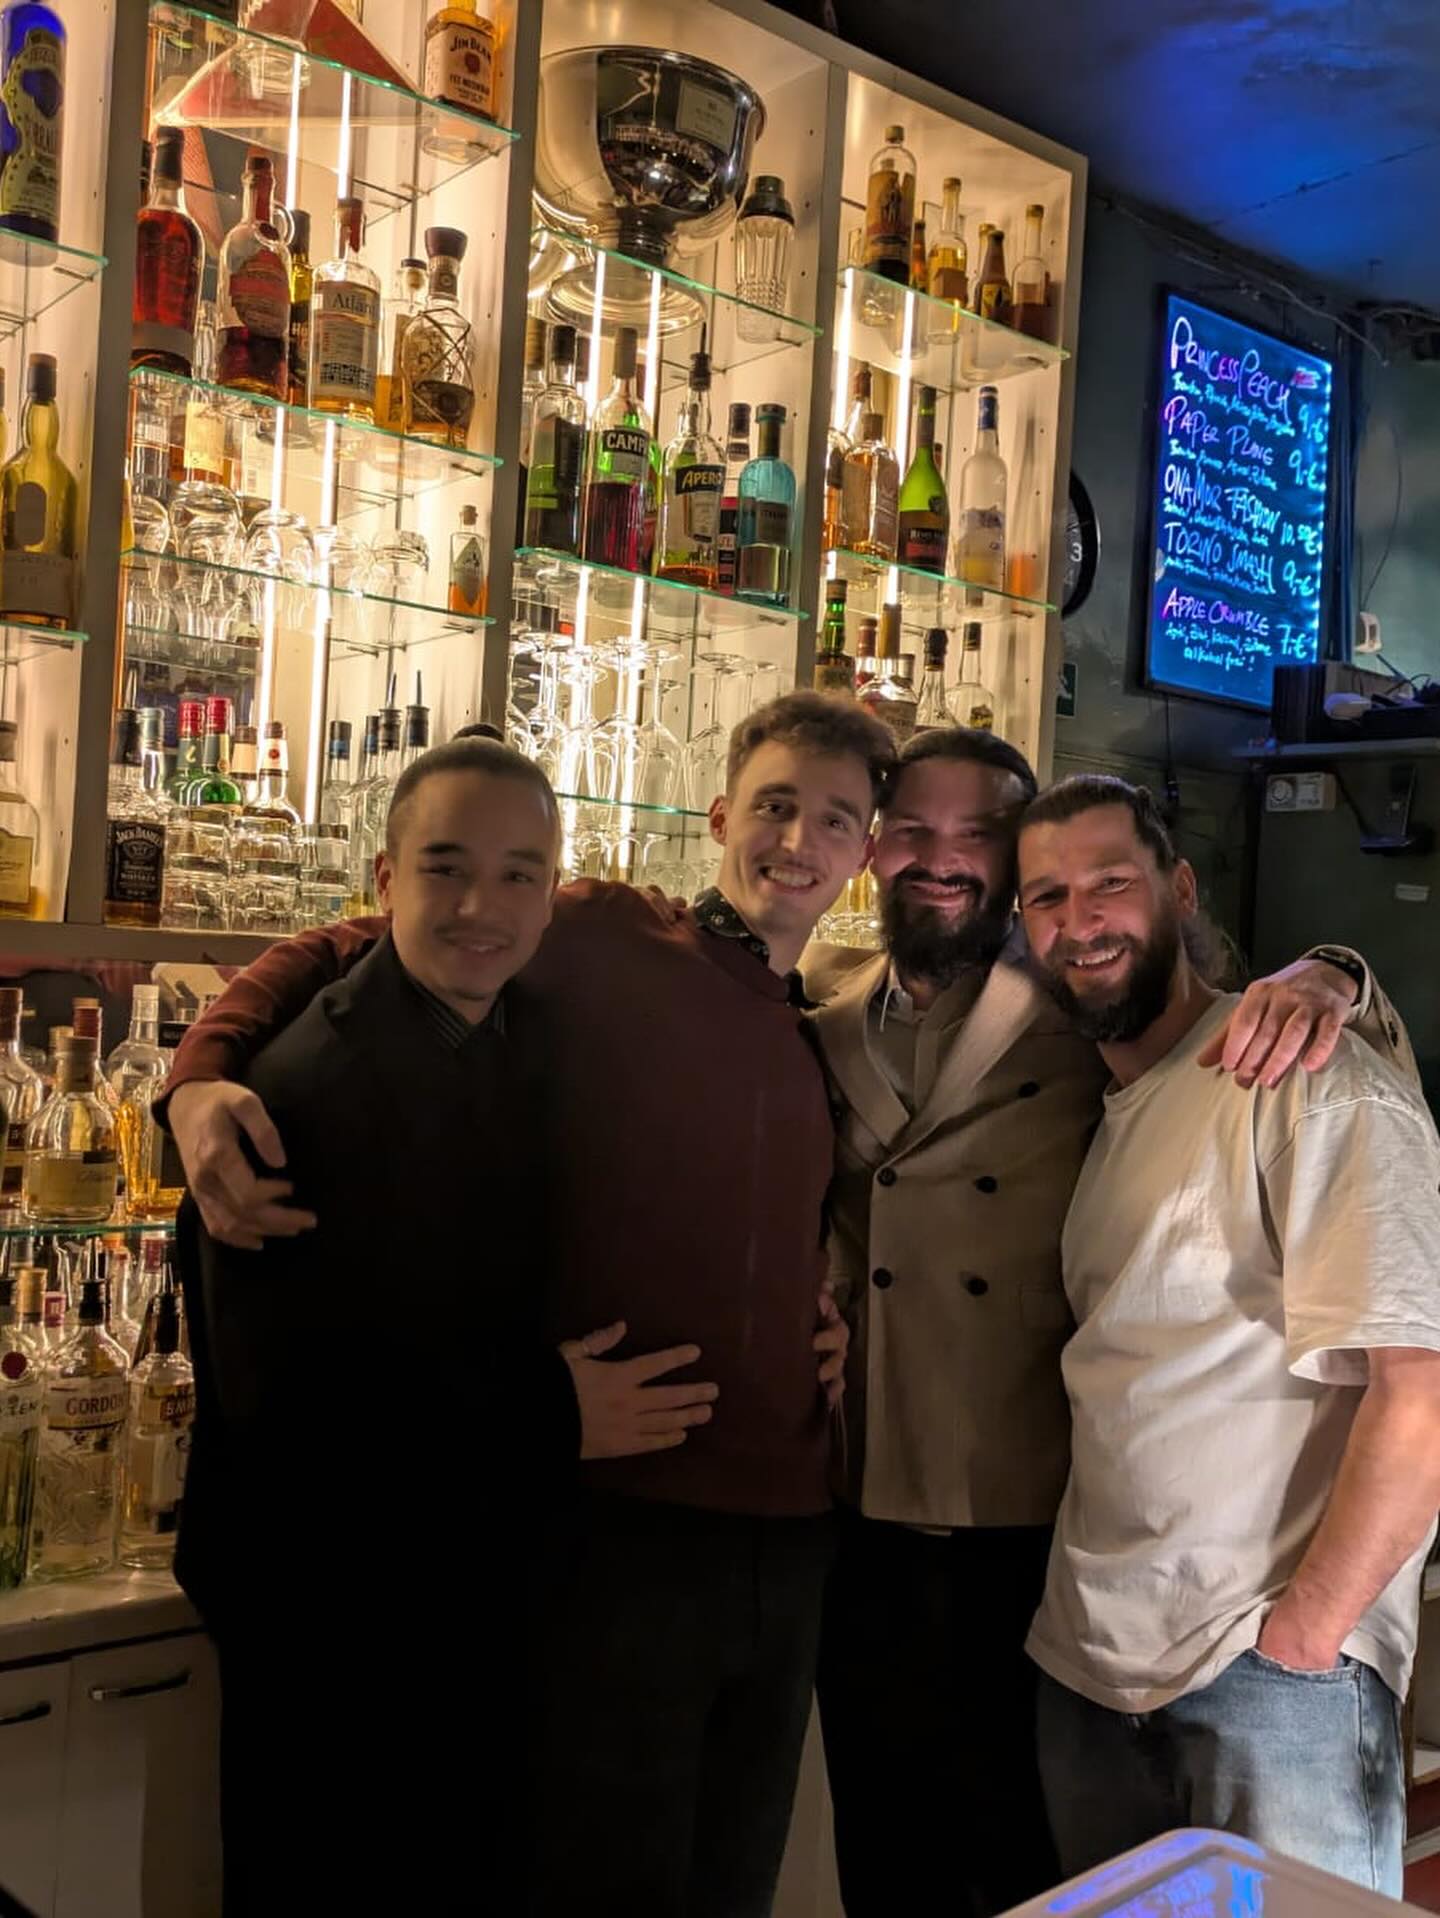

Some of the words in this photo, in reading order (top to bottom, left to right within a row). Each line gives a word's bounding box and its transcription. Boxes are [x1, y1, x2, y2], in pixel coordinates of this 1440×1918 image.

[1170, 316, 1240, 383] PRINCESS
[1238, 348, 1291, 425] PEACH
[1164, 395, 1219, 449] PAPER
[1070, 541, 1083, 562] 3
[1164, 522, 1222, 565] TORINO
[1227, 543, 1276, 595] SMASH
[1161, 587, 1206, 620] APPLE
[1208, 600, 1270, 636] CRUMBLE
